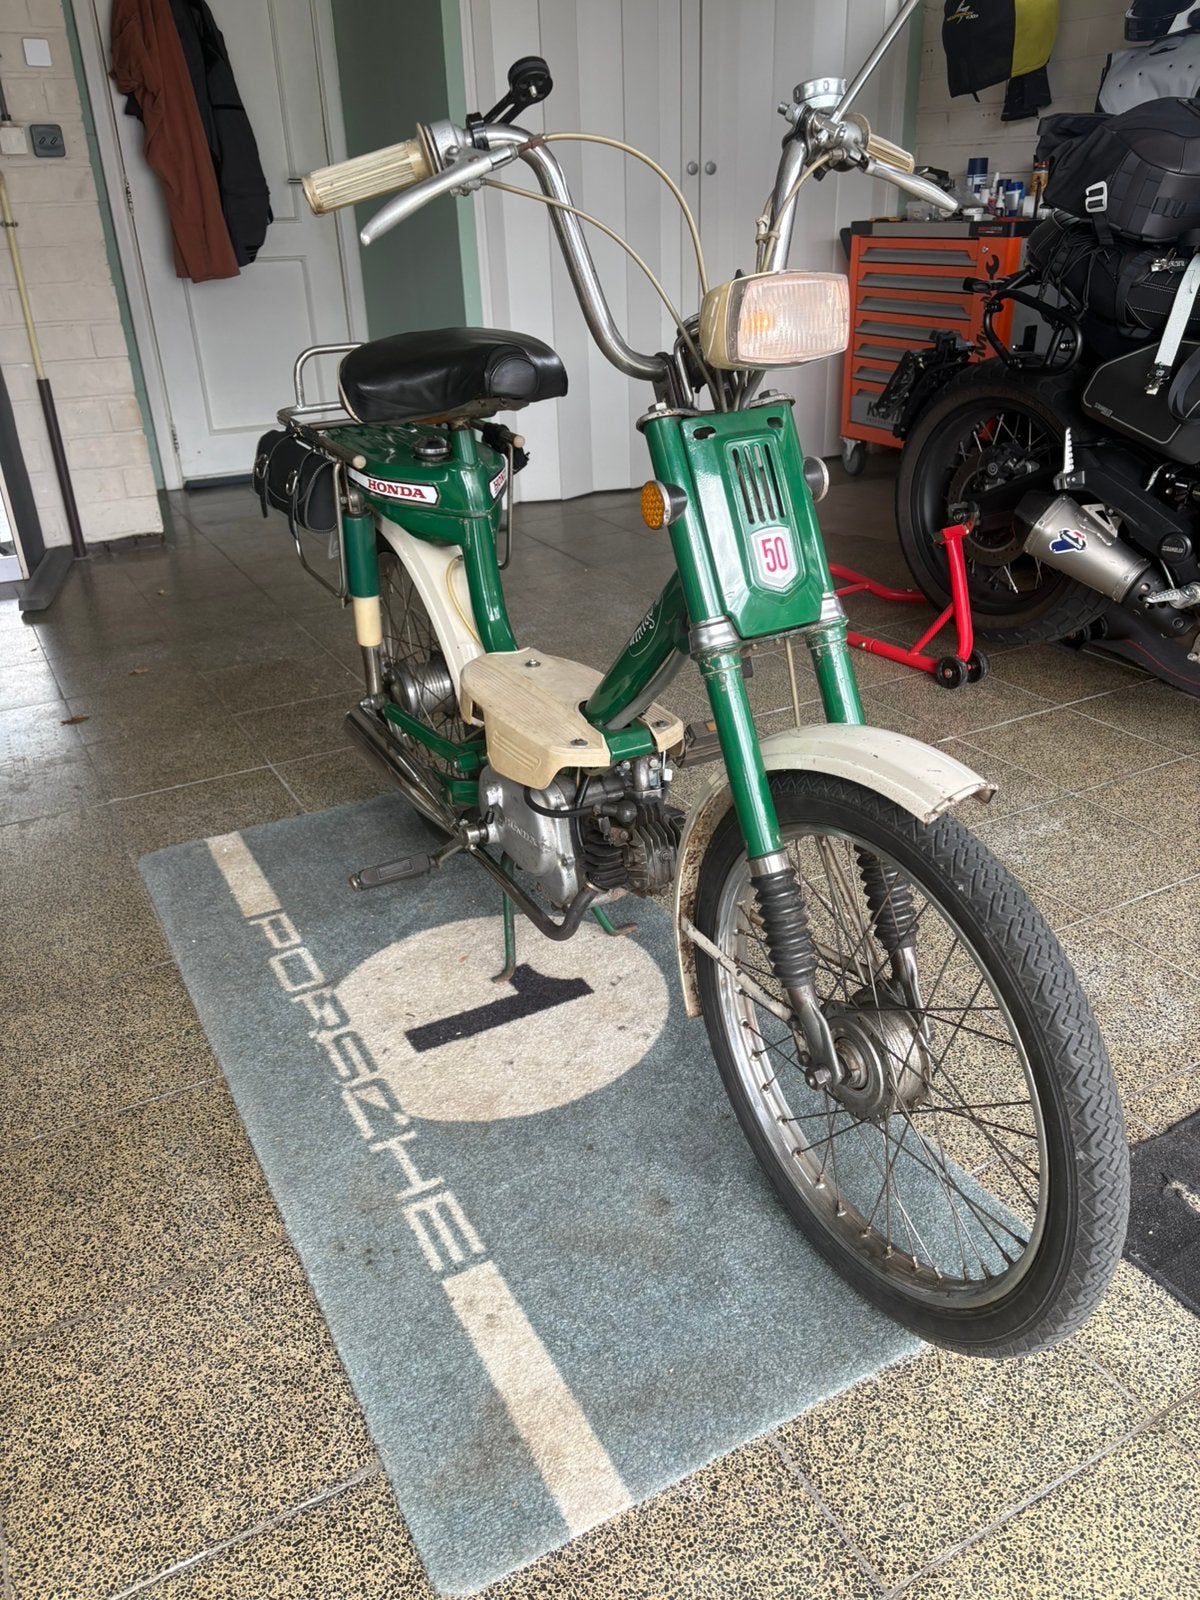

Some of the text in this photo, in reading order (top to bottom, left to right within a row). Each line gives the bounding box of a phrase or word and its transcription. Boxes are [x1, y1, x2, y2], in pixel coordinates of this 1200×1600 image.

[367, 478, 427, 499] HONDA
[760, 535, 789, 573] 50
[504, 816, 539, 848] HONDA
[403, 962, 596, 1054] 1
[250, 912, 485, 1272] PORSCHE
